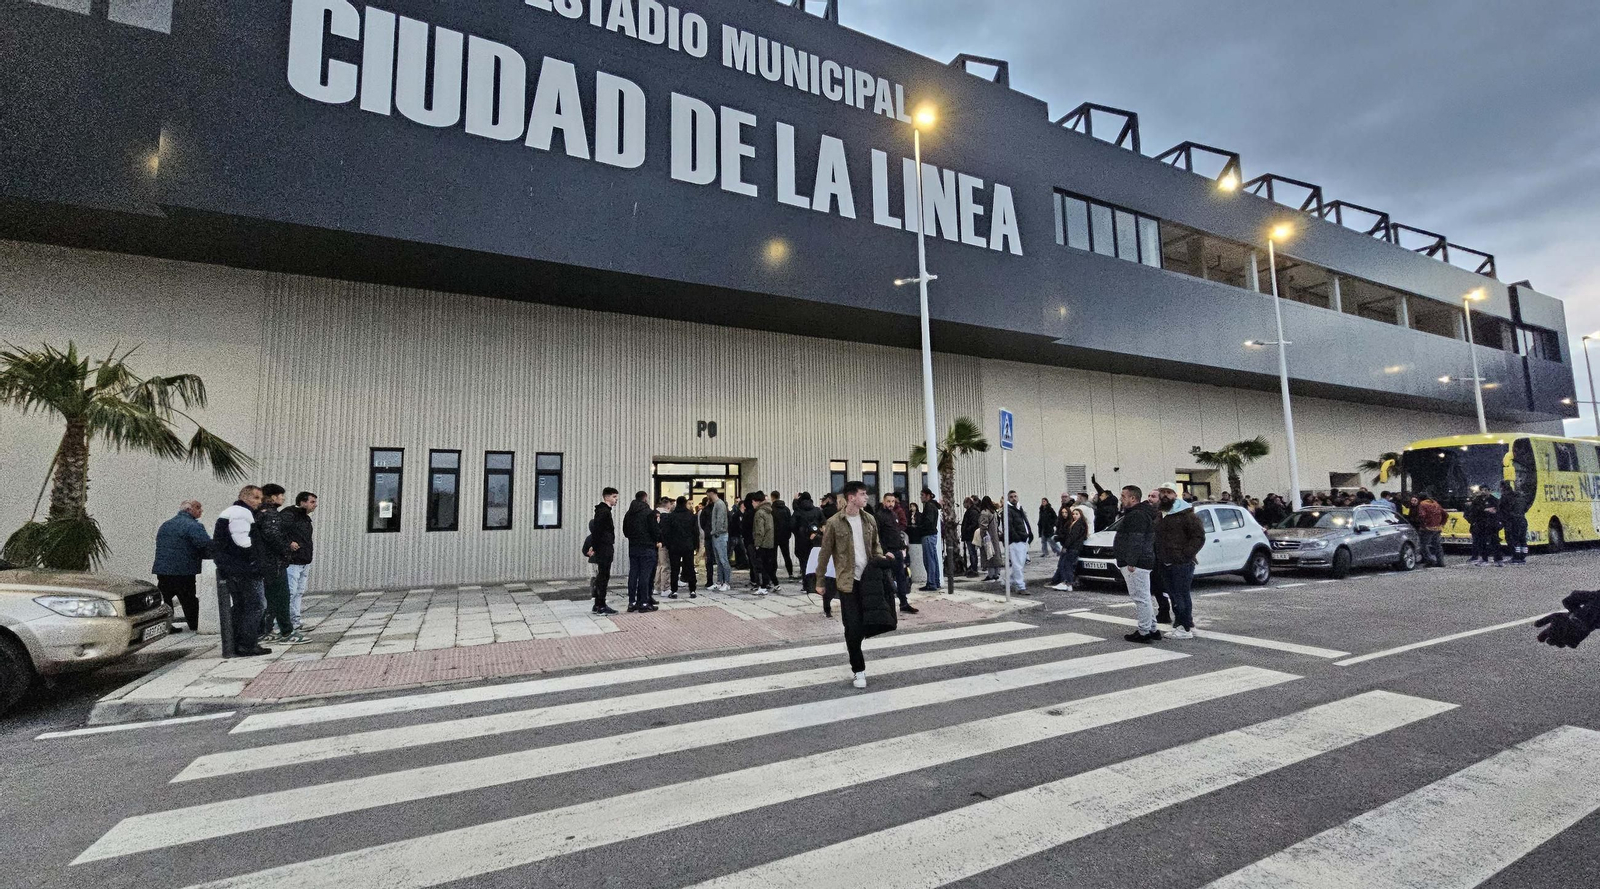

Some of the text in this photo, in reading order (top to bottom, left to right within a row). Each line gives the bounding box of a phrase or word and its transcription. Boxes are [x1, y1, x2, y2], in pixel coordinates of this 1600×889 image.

[525, 0, 912, 124] TADIO MUNICIPAL
[287, 0, 1023, 256] CIUDAD DE LA LINEA
[1544, 483, 1576, 502] FELICES
